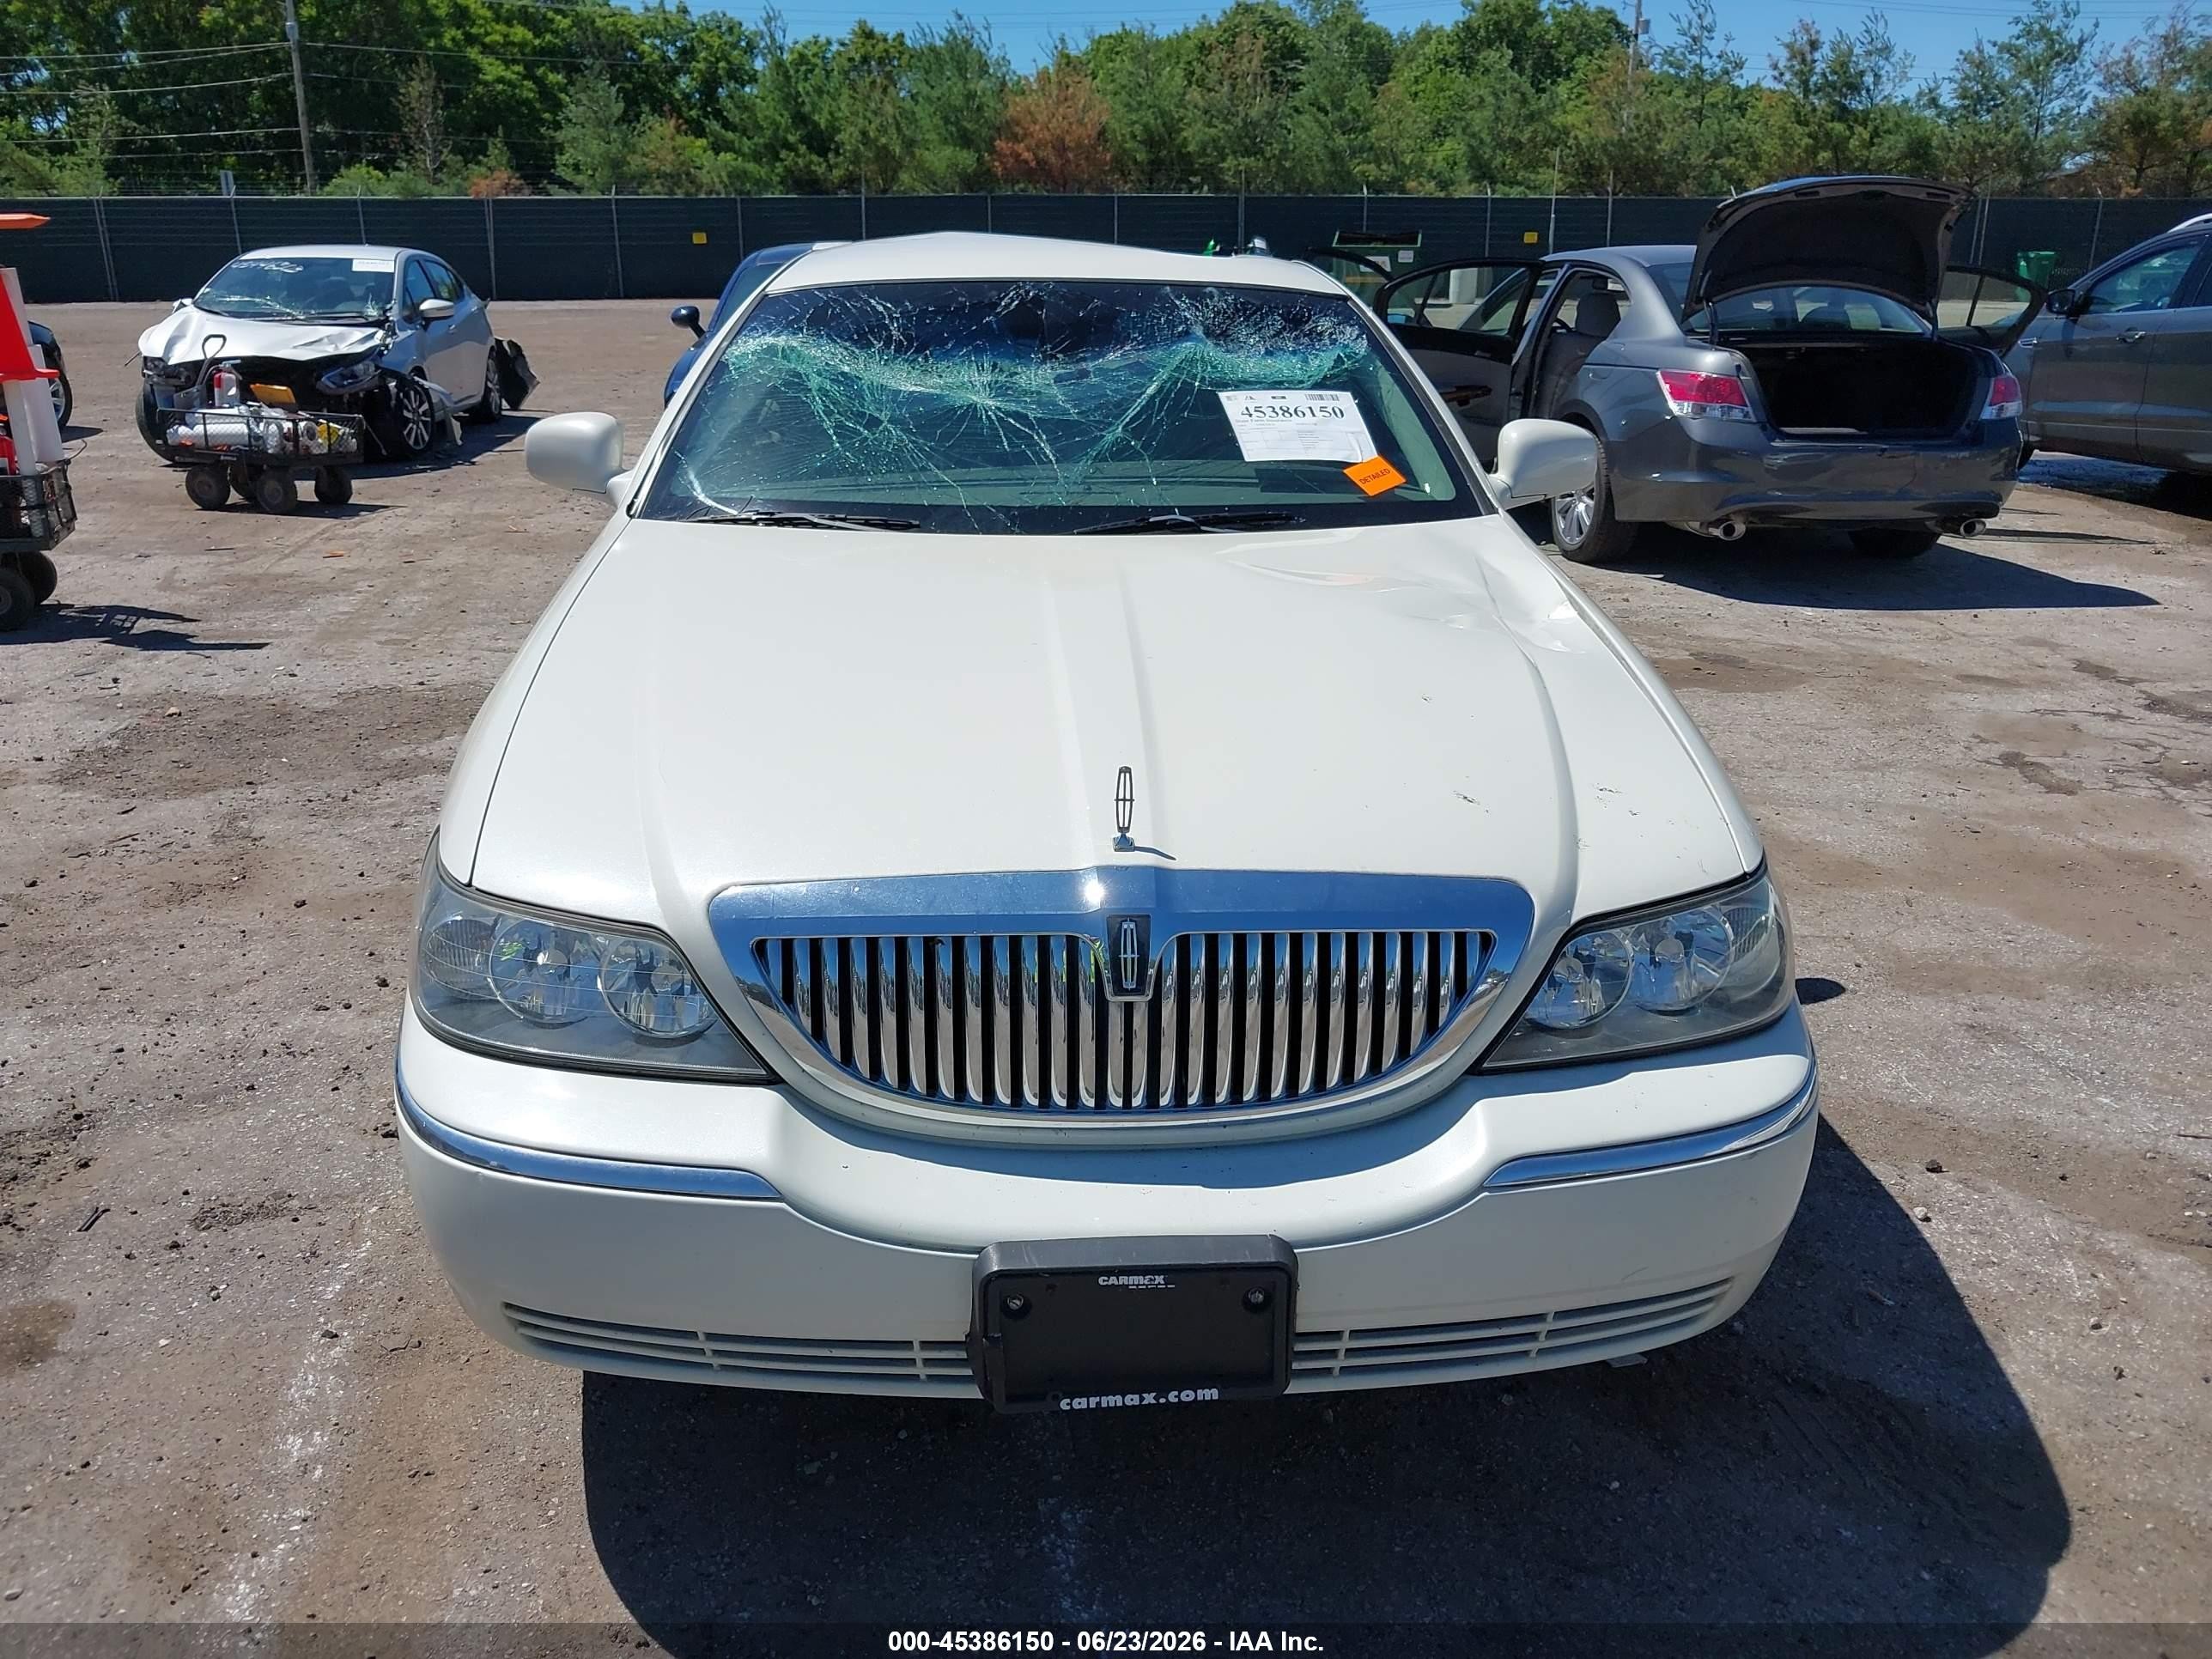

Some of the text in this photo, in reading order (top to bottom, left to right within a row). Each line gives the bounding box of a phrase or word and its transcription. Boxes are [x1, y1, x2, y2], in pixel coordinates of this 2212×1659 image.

[1241, 405, 1345, 419] 45386150
[1358, 468, 1391, 485] DETAILED
[1059, 1387, 1219, 1411] carmax.com
